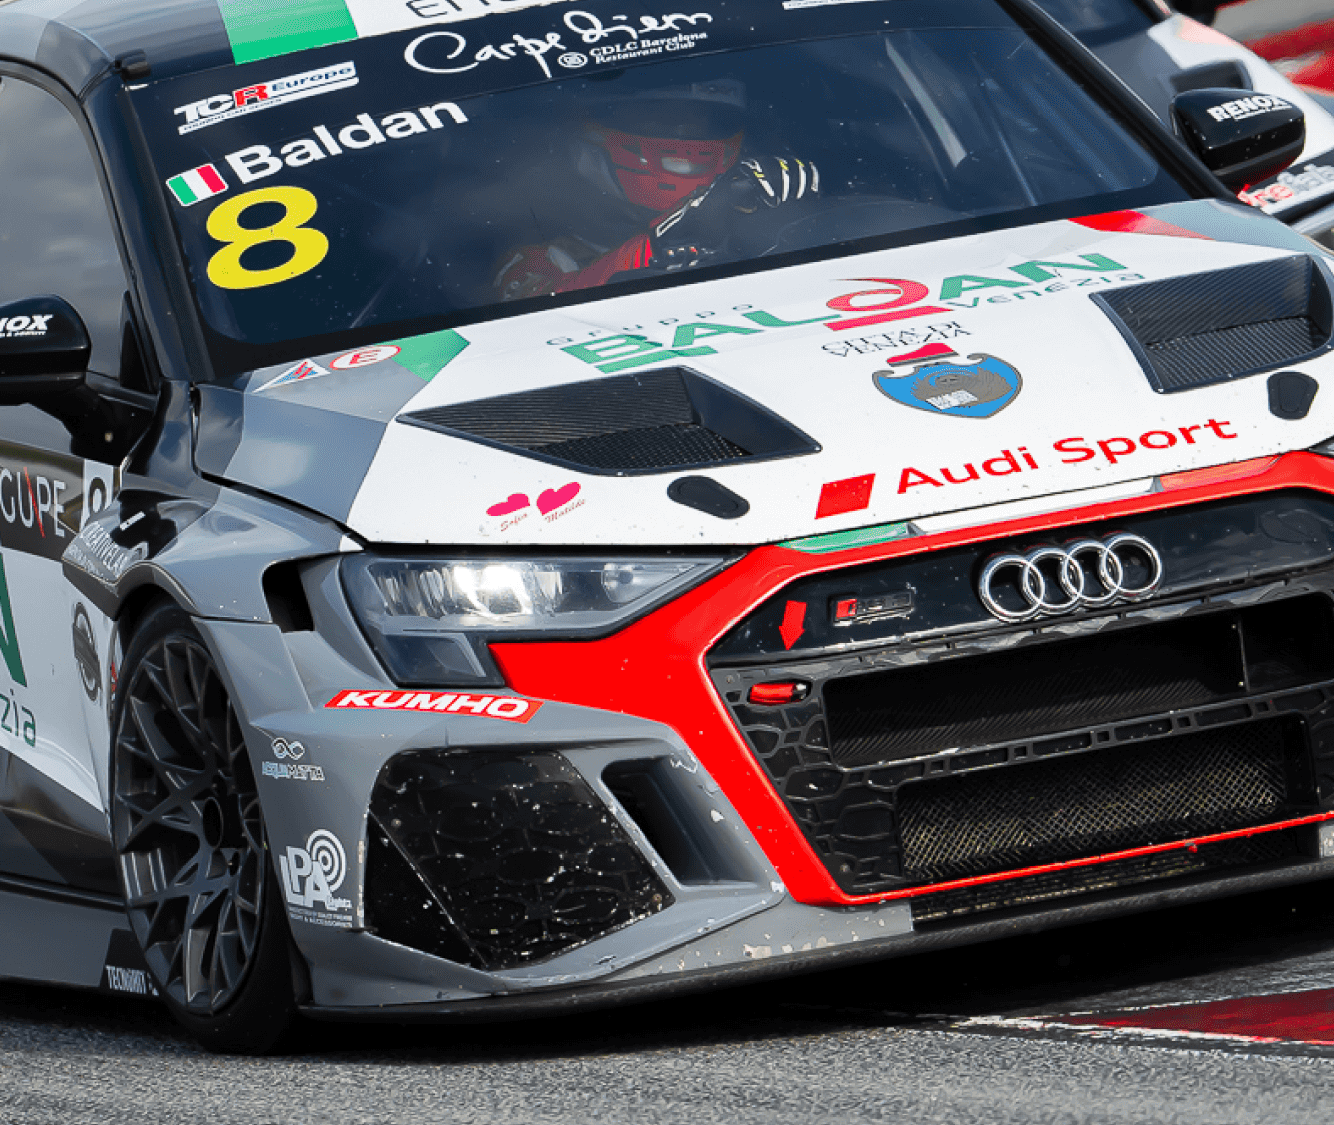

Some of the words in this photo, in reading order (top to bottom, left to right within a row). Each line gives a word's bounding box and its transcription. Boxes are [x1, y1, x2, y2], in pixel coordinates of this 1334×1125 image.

[404, 30, 567, 79] Carpe
[563, 10, 713, 43] Diem
[589, 41, 639, 58] CDLC
[641, 30, 708, 47] Barcelona
[594, 46, 664, 65] Restaurant
[665, 37, 696, 52] Club
[173, 83, 268, 125] TCR
[271, 66, 353, 92] Europe
[1206, 95, 1289, 122] RENOX
[224, 101, 469, 184] Baldan
[206, 185, 329, 289] 8
[947, 272, 1147, 309] Venezia
[895, 446, 1040, 496] Audi
[1052, 417, 1239, 467] Sport
[337, 690, 530, 719] KUMHO
[278, 845, 332, 908] LPA
